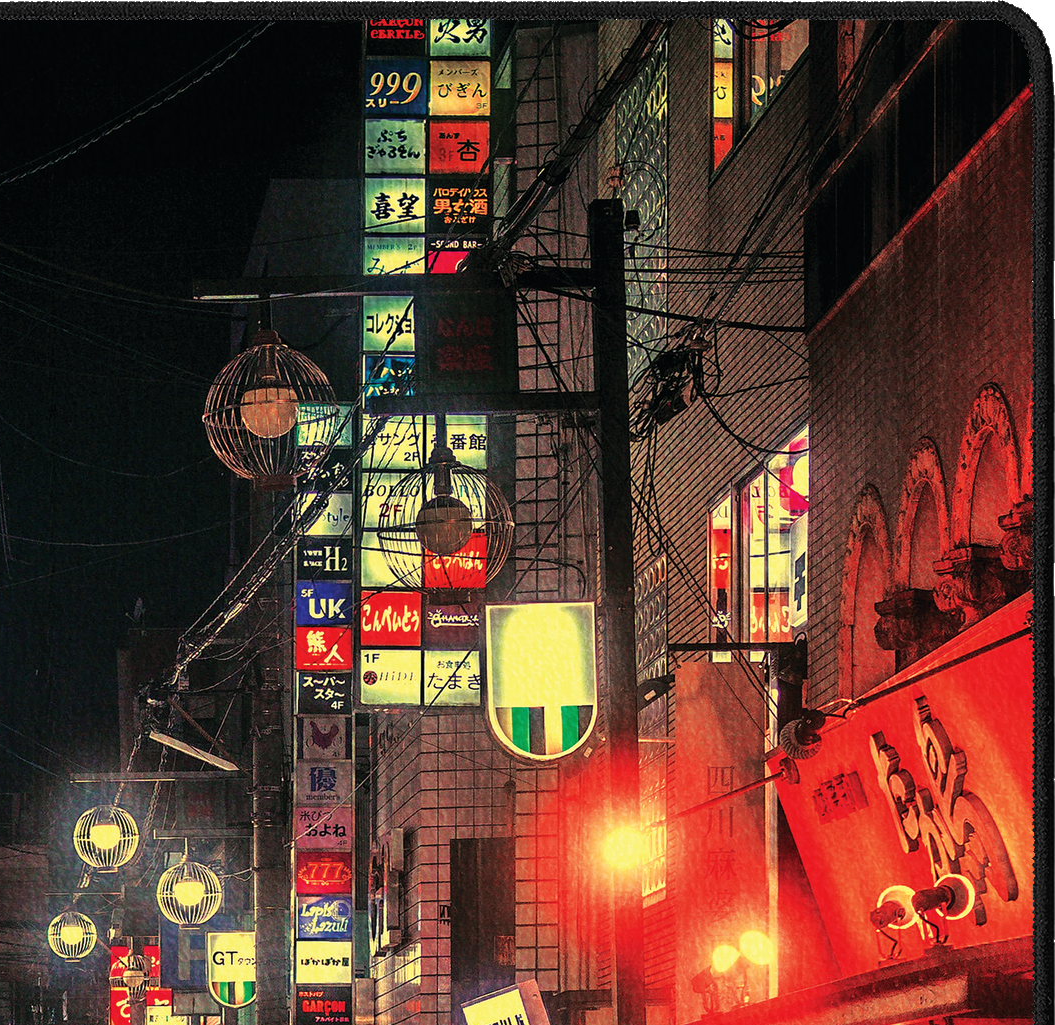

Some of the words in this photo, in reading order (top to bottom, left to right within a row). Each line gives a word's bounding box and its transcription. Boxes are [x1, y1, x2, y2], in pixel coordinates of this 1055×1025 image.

[437, 68, 479, 76] メンバーズ
[370, 72, 422, 104] 999
[437, 83, 487, 98] びぎん
[457, 139, 480, 161] 杏
[370, 192, 420, 220] 喜望
[431, 433, 487, 451] 番館
[323, 508, 350, 526] tyle
[301, 589, 314, 598] 5F
[308, 598, 346, 619] UK
[363, 604, 420, 632] こんぺいとう
[364, 653, 380, 663] 1F
[427, 672, 481, 690] たまき
[330, 701, 344, 710] 4F
[309, 766, 337, 792] 優
[305, 823, 347, 837] およね
[307, 863, 345, 879] 777
